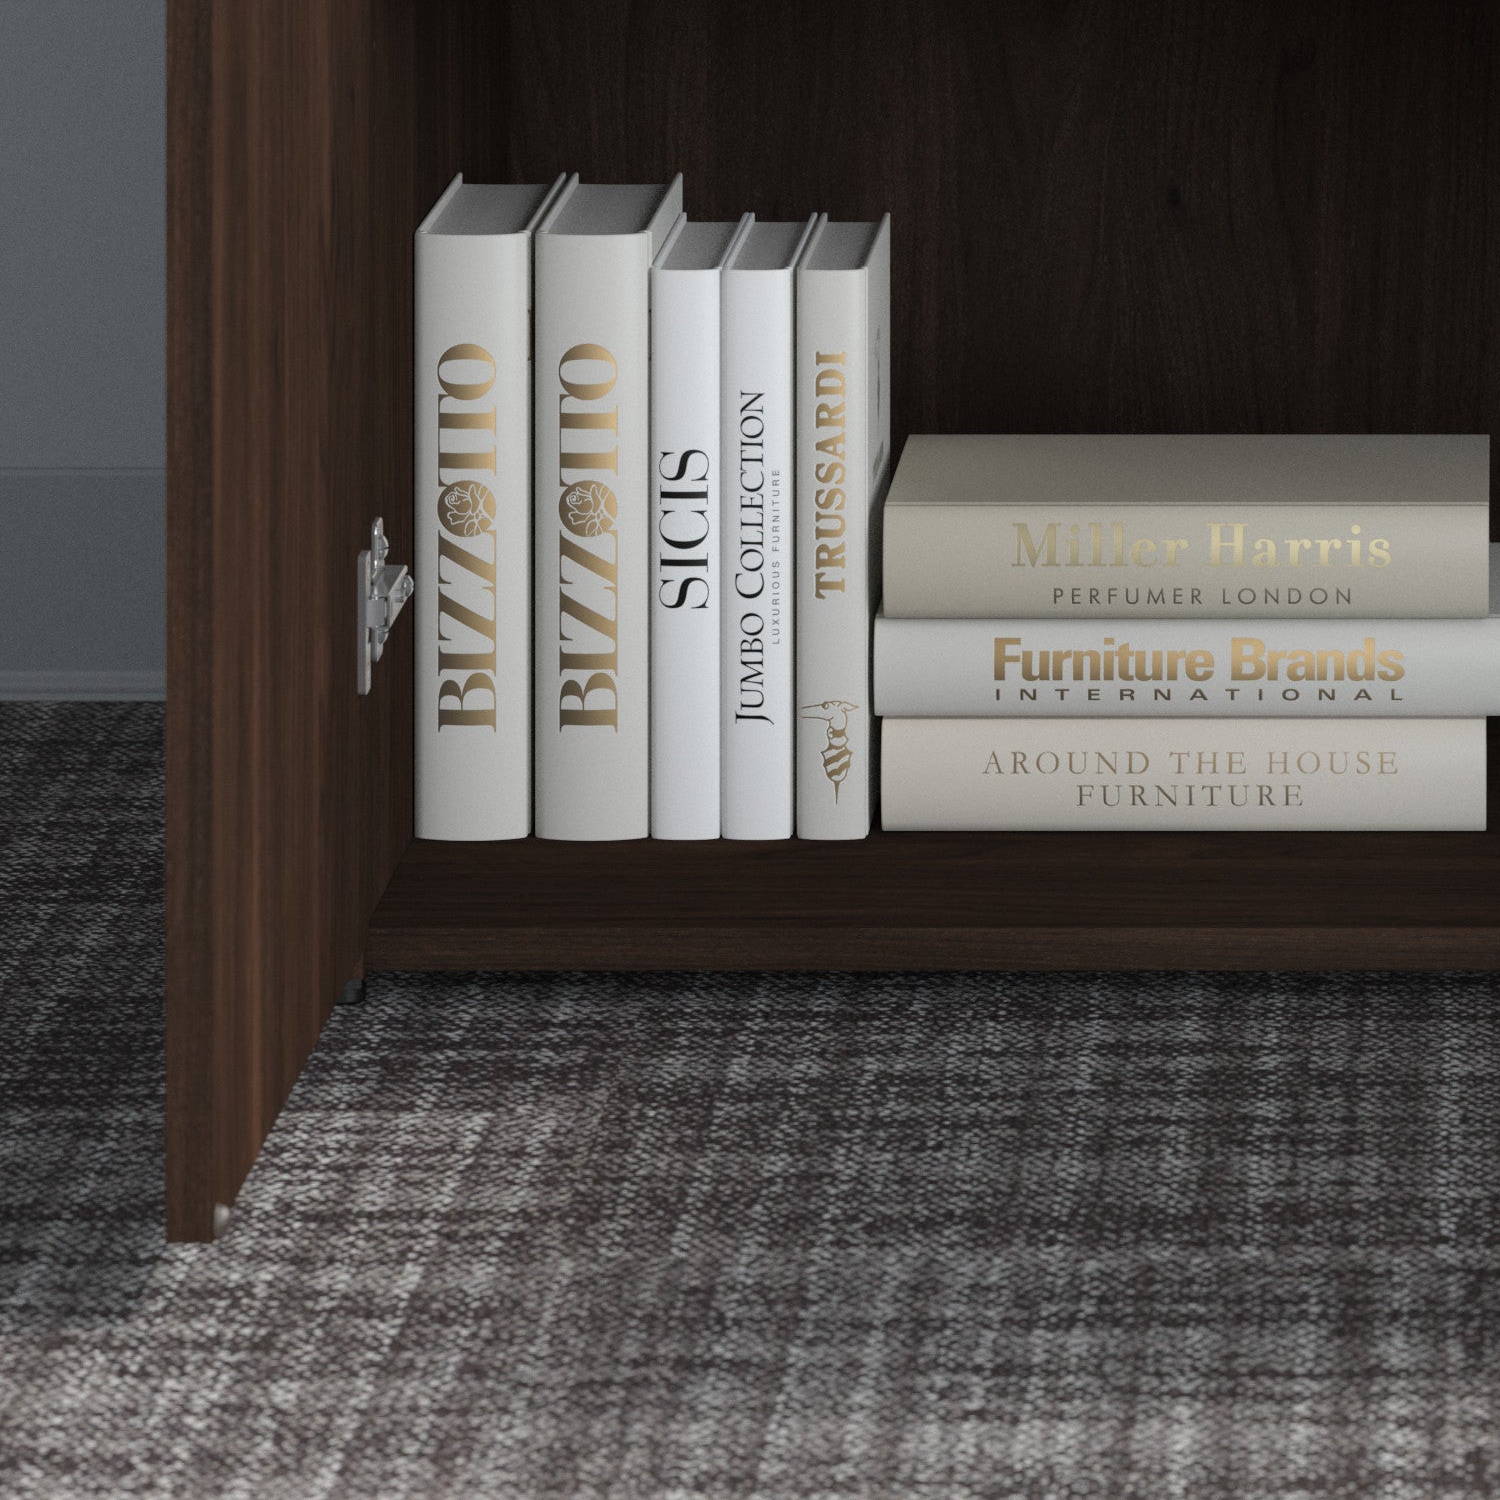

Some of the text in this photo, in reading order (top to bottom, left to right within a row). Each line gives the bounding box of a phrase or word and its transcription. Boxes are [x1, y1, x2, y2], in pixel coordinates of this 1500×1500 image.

[815, 351, 846, 600] TRUSSARDI
[658, 449, 709, 609] SICIS
[1011, 522, 1392, 568] Miller Harris
[734, 390, 775, 725] JUMBO COLLECTION
[772, 469, 780, 645] LUXURIOUS FURNITURE
[1053, 588, 1352, 605] PERFUMER LONDON
[993, 637, 1406, 682] Furniture Brands
[995, 688, 1403, 701] INTERNATIONAL
[982, 751, 1398, 775] AROUND THE HOUSE
[1076, 784, 1304, 808] FURNITURE
